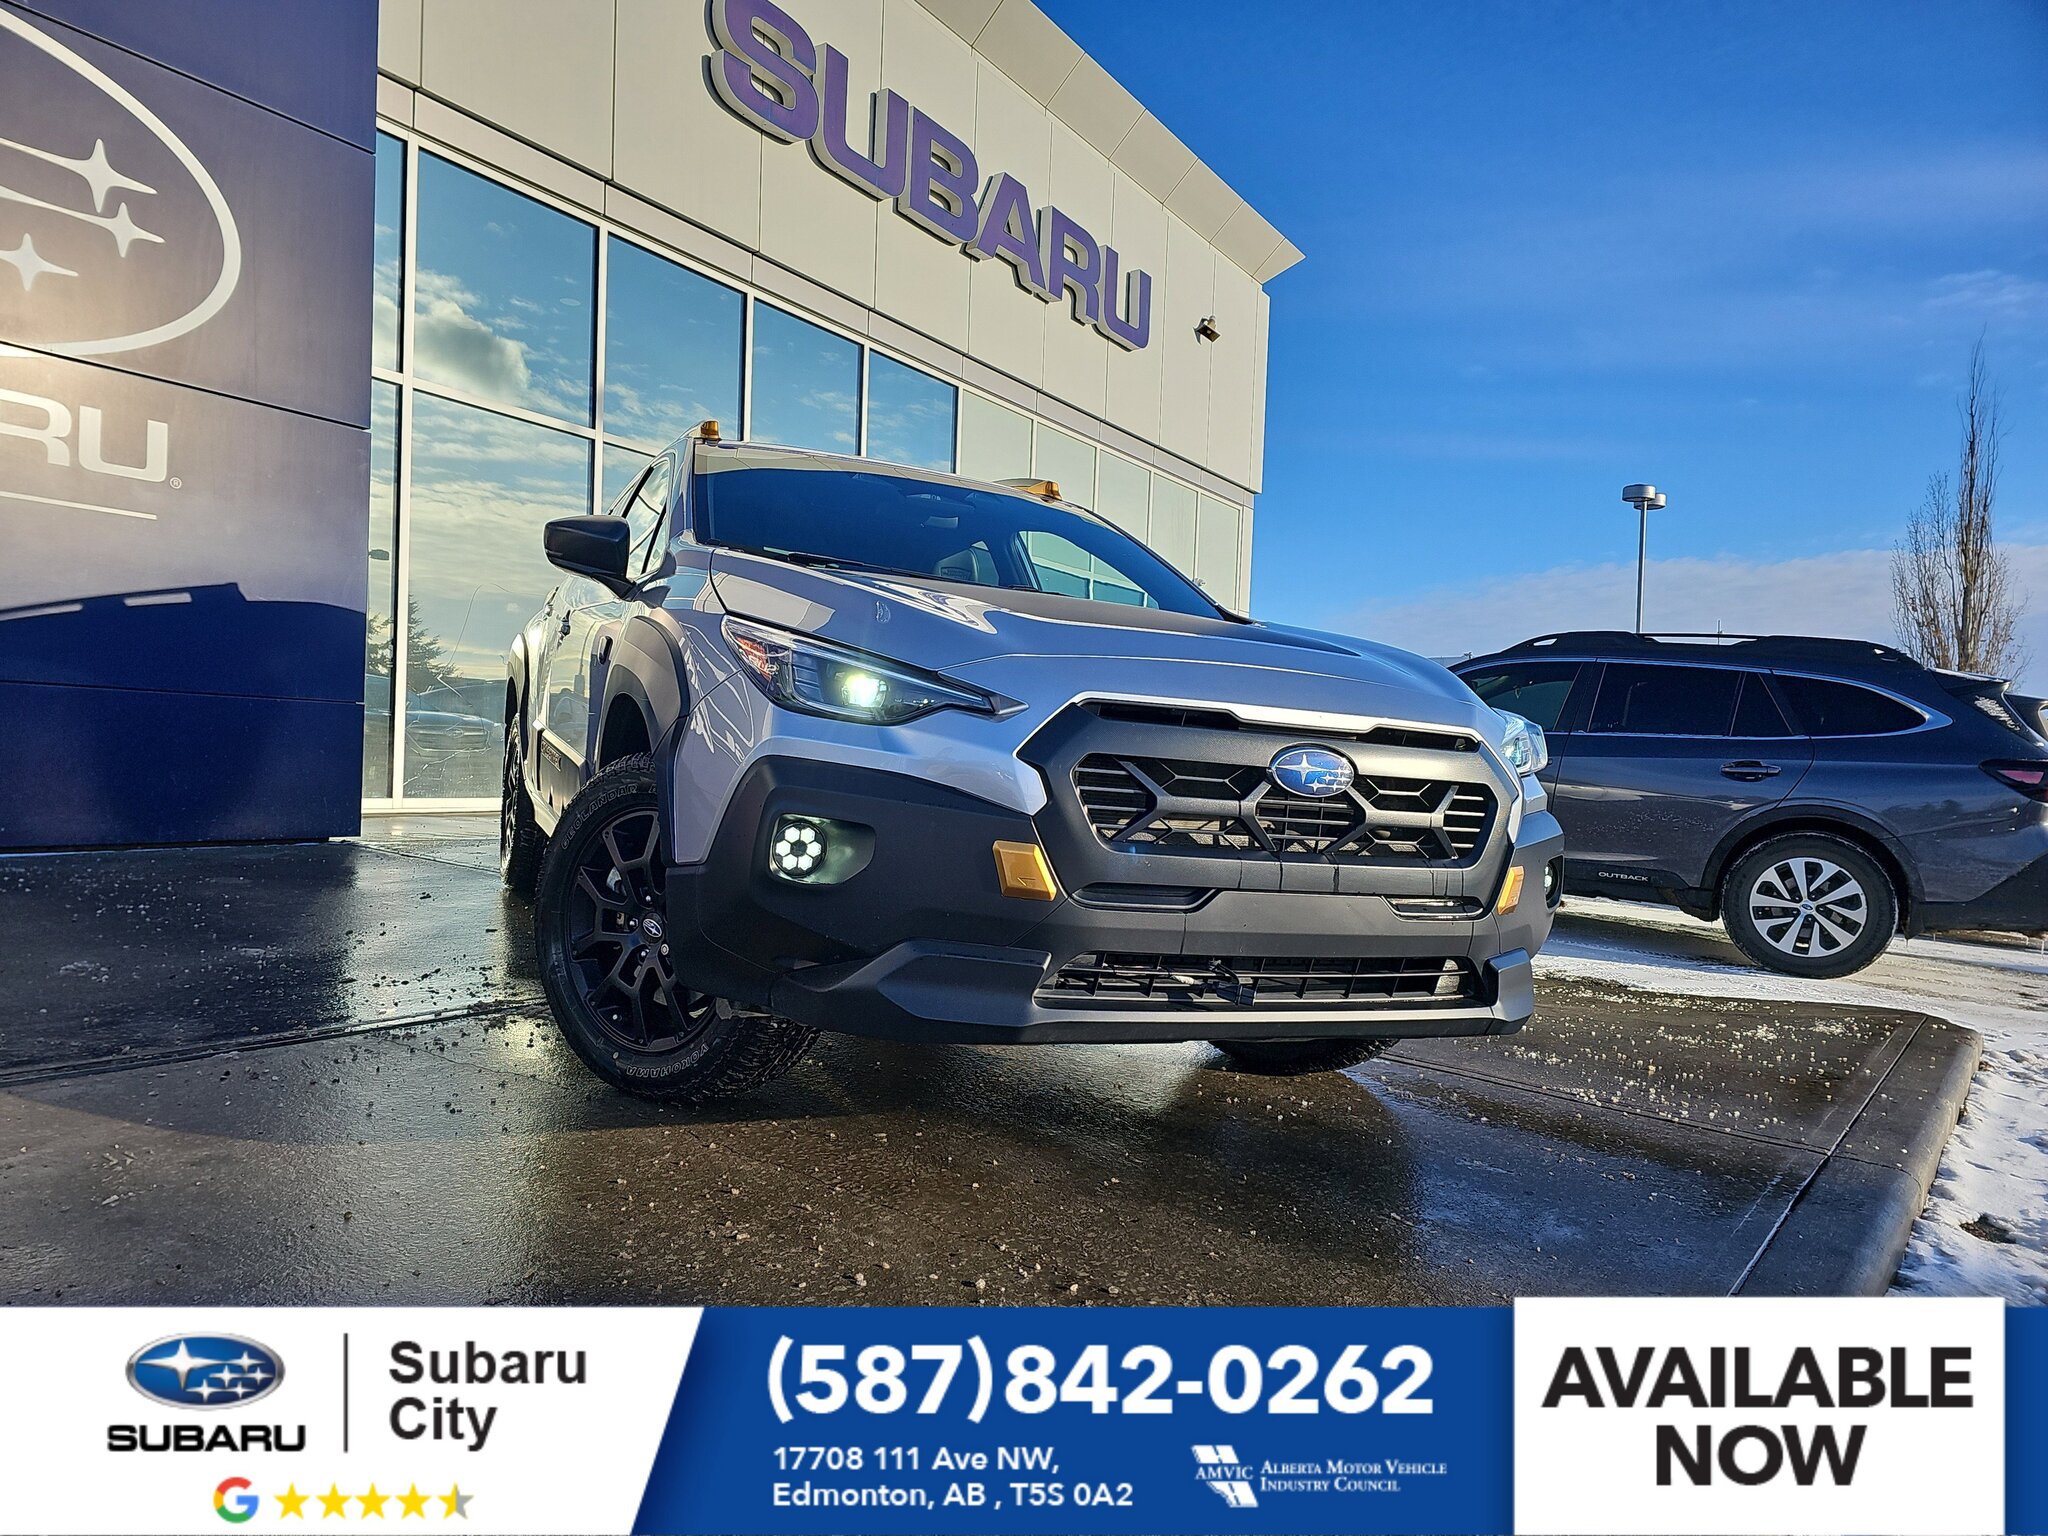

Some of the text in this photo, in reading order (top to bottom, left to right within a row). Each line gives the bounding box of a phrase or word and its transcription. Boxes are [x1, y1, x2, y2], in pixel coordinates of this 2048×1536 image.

[701, 0, 1152, 352] SUBARU
[561, 783, 639, 850] GEOLANDAR
[1598, 871, 1649, 882] OUTBACK
[626, 1043, 710, 1078] YOKOHAMA
